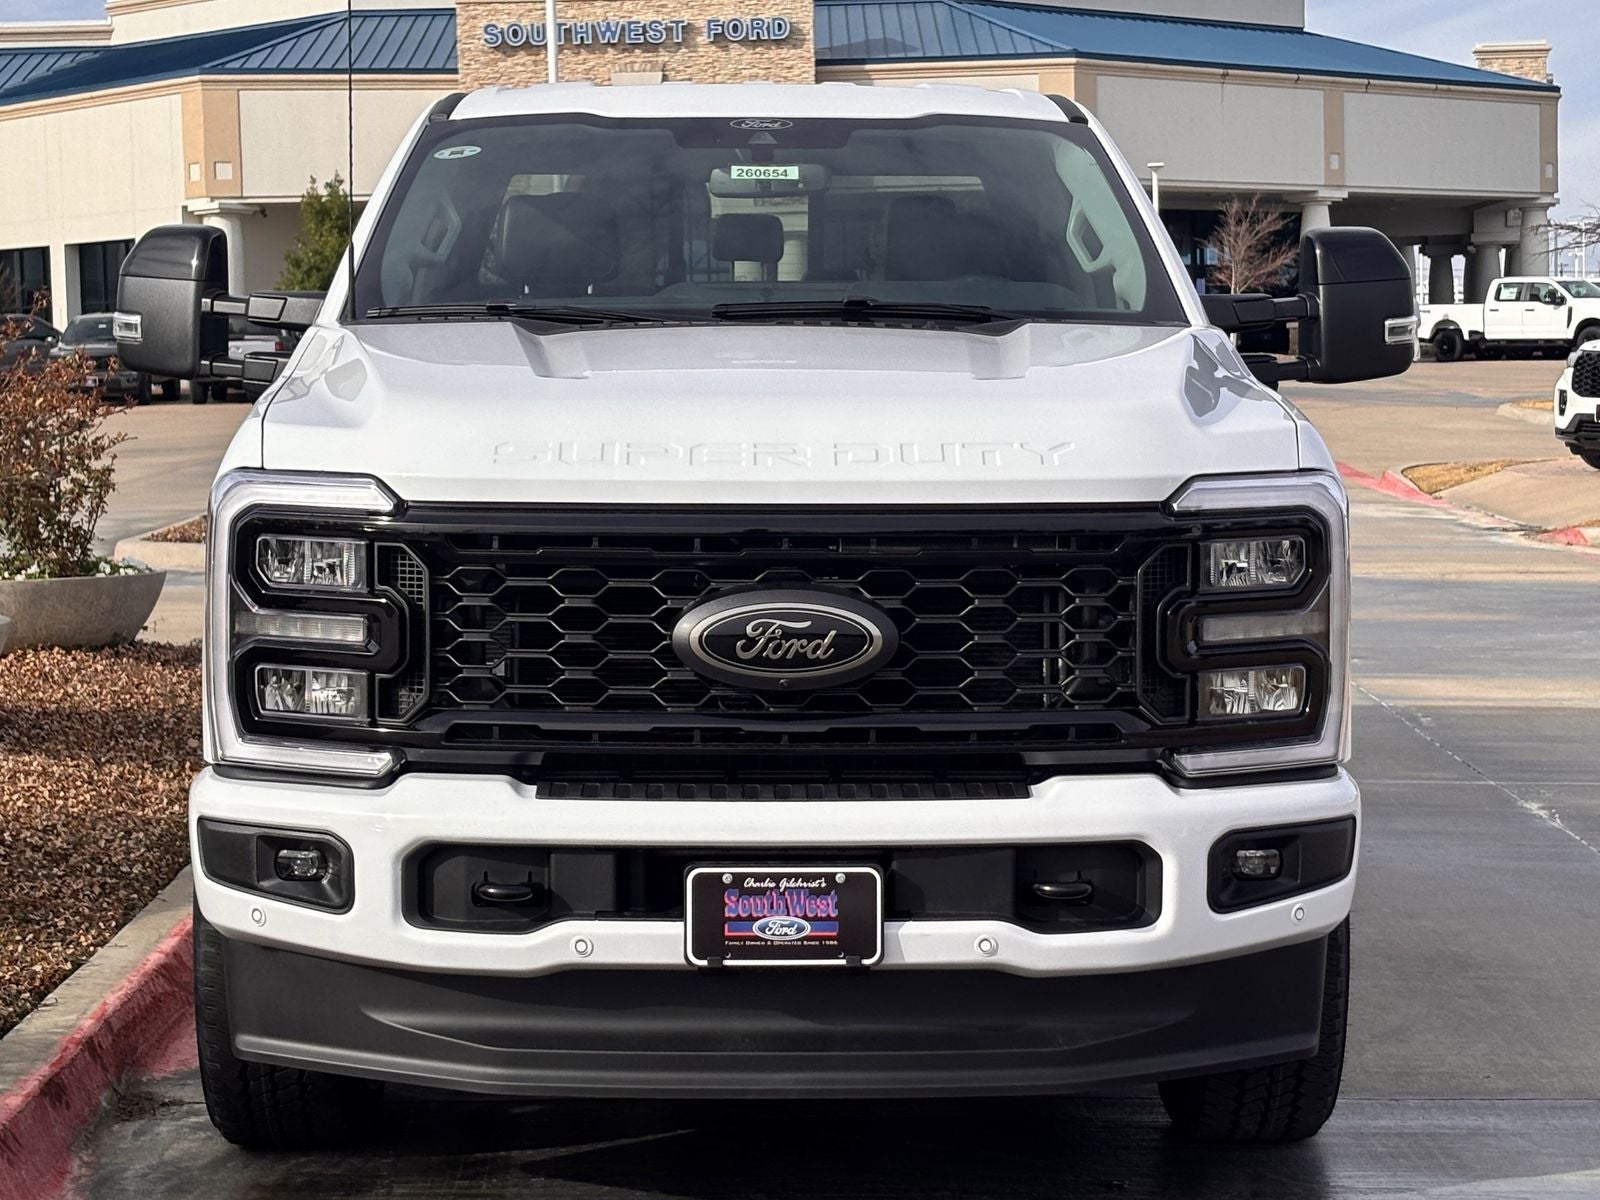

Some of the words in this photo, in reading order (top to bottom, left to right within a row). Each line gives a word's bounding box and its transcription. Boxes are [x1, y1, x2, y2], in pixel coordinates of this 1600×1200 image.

[483, 19, 687, 47] SOUTHWEST
[706, 16, 790, 42] FORD
[741, 119, 781, 128] Ford
[736, 168, 789, 178] 260654
[493, 441, 812, 466] SUPER
[833, 441, 1076, 466] DUTY
[735, 618, 837, 660] Ford
[724, 888, 838, 918] SouthWest
[765, 920, 798, 935] Ford
